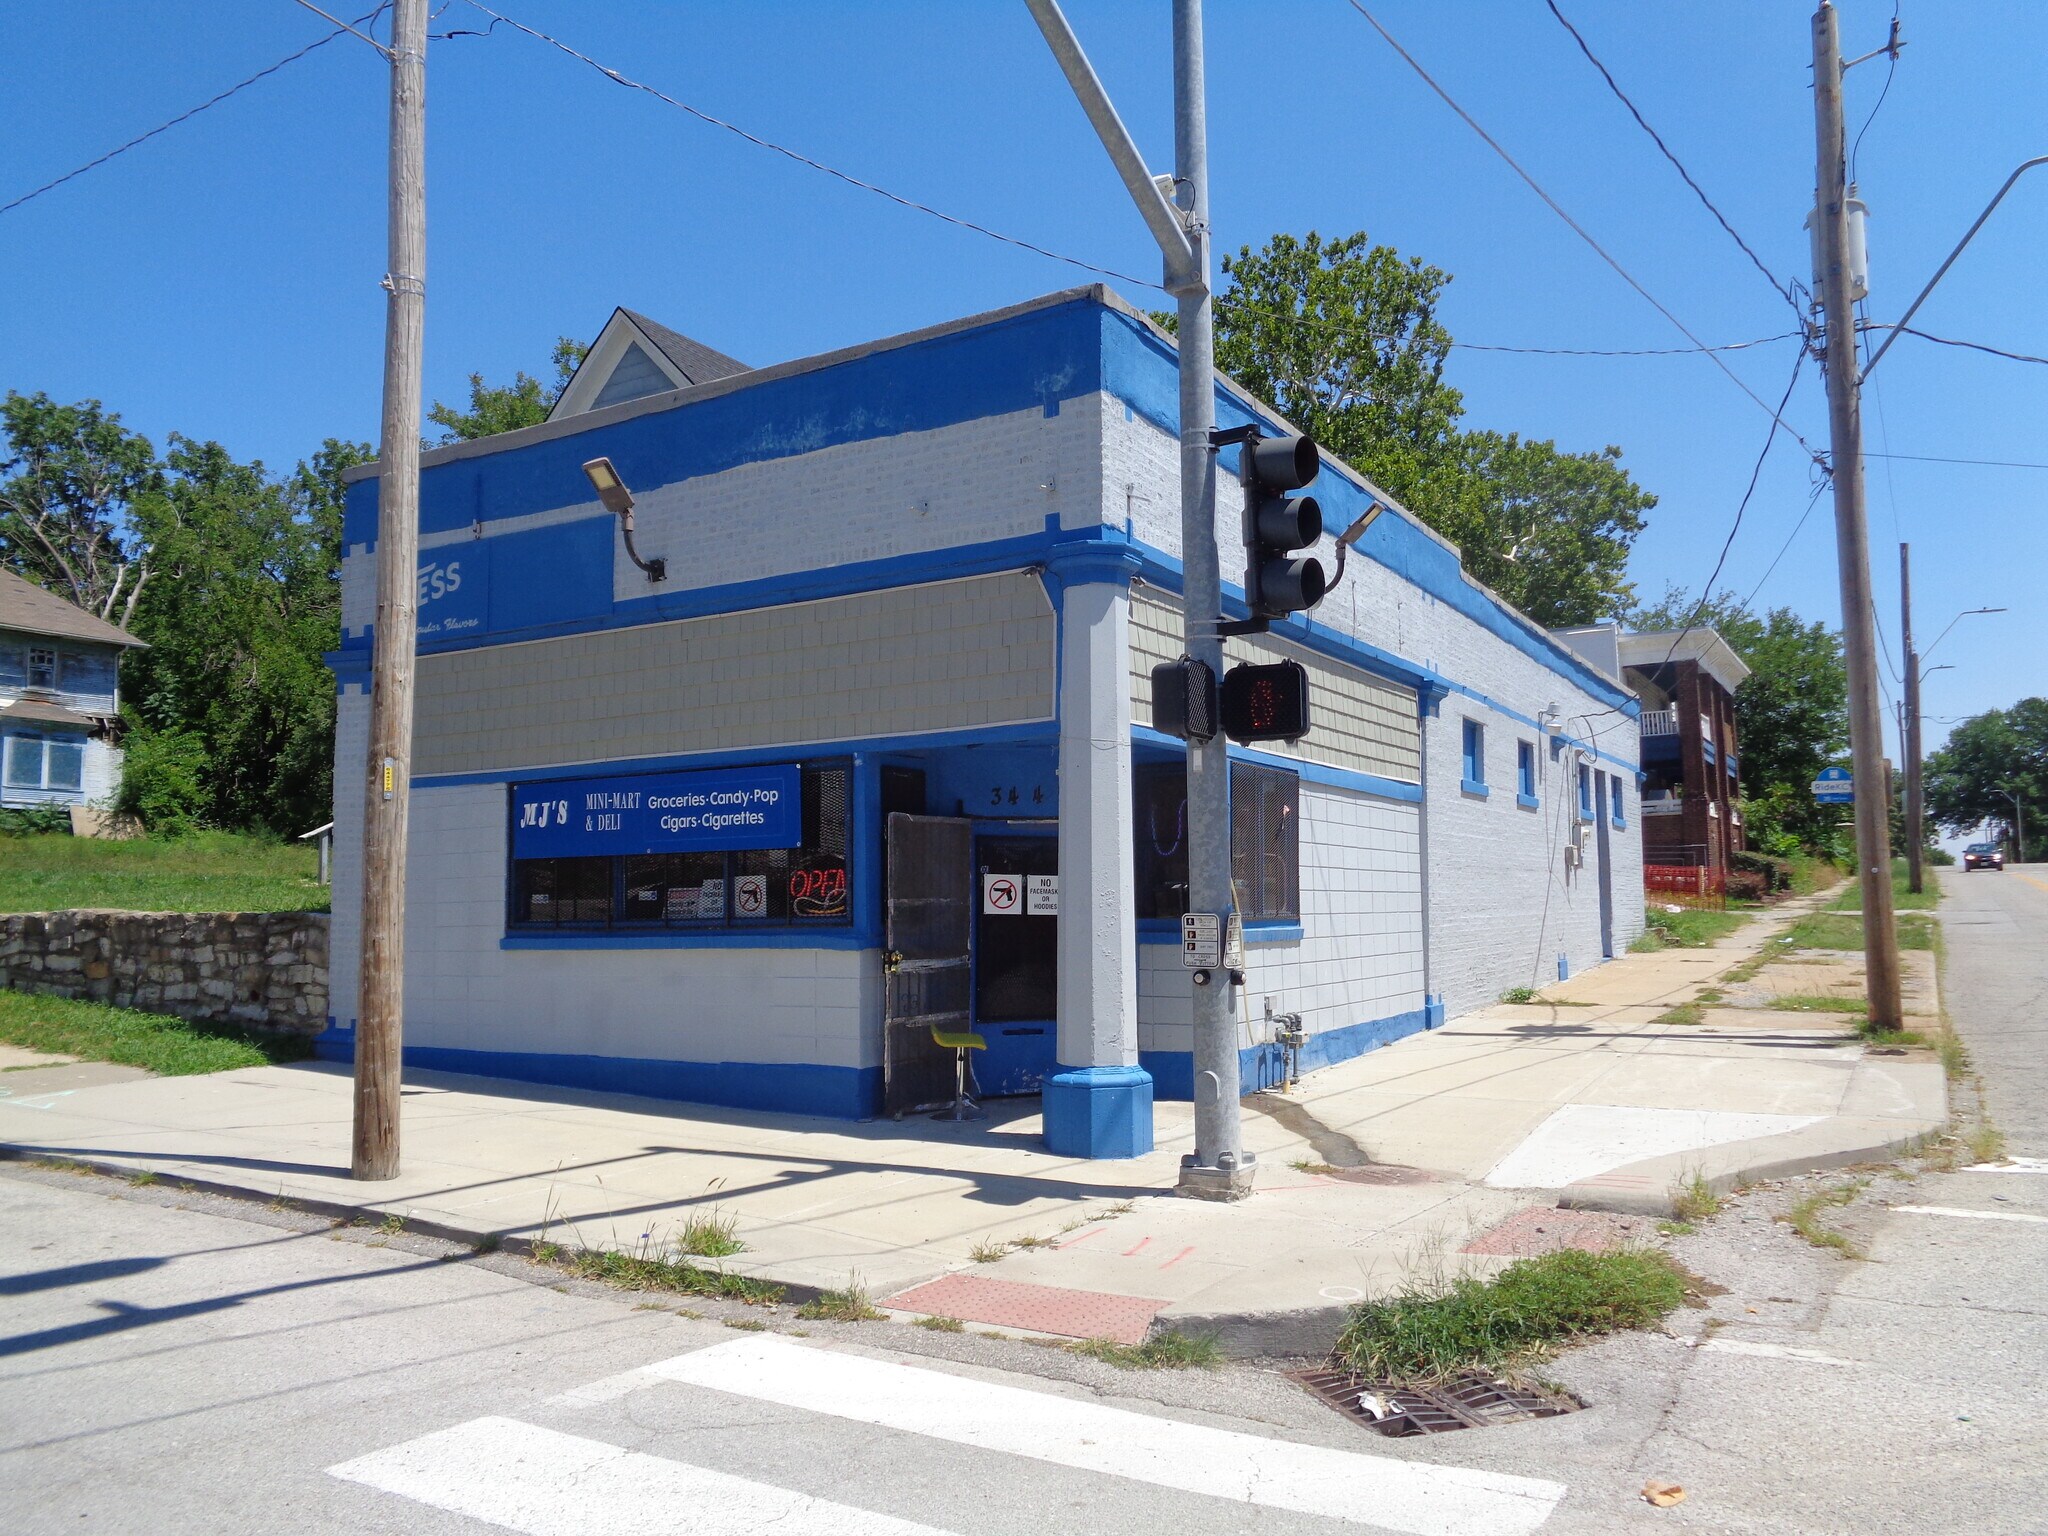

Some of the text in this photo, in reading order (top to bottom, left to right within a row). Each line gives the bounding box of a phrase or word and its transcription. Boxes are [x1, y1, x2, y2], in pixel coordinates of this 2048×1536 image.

[444, 618, 479, 631] Flavors
[586, 792, 641, 810] MINI-MART
[520, 800, 568, 829] MJ'S
[585, 813, 621, 832] & DELI
[790, 869, 846, 897] OPEN
[1040, 878, 1052, 888] NO
[1041, 895, 1050, 903] OR
